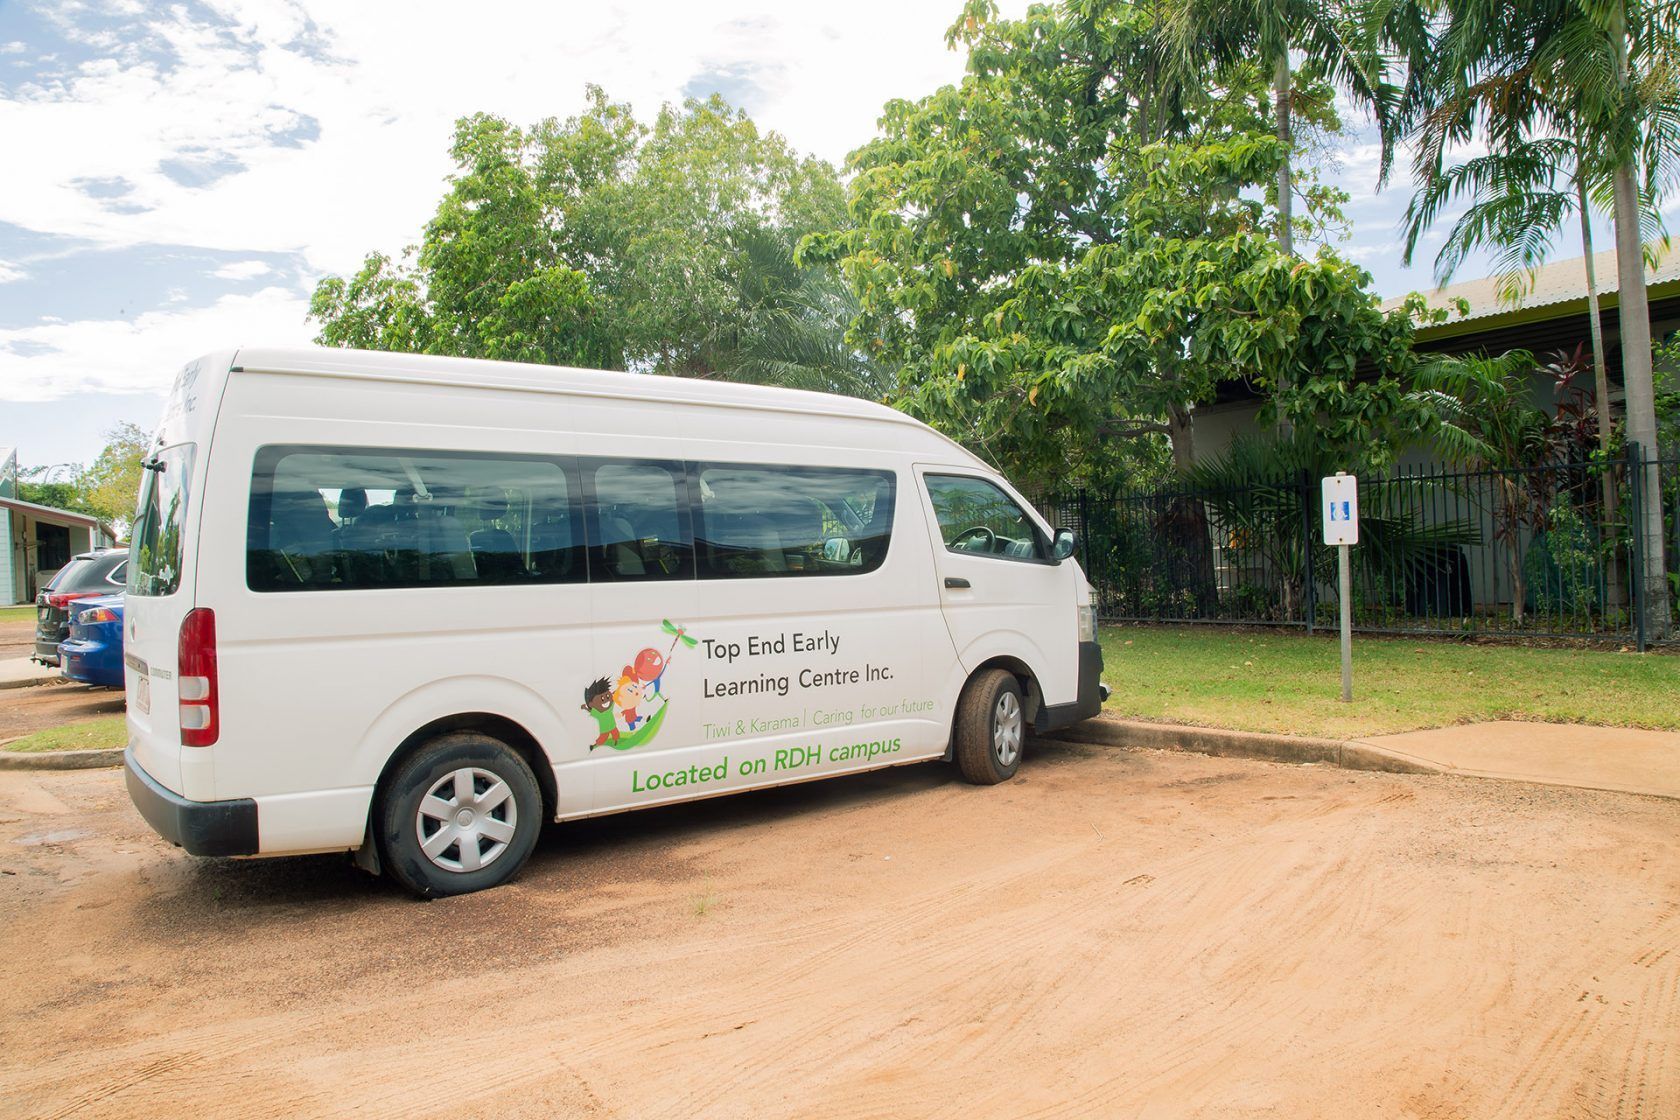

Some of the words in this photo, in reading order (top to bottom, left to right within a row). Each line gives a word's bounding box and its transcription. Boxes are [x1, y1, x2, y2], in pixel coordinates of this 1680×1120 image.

[702, 639, 740, 663] Top
[748, 633, 785, 656] End
[793, 630, 839, 655] Early
[704, 673, 788, 698] Learning
[799, 669, 859, 688] Centre
[866, 664, 893, 681] Inc.
[703, 722, 731, 740] Tiwi
[735, 720, 745, 736] &
[751, 717, 799, 734] Karama
[813, 710, 853, 727] Caring
[861, 704, 876, 718] for
[880, 705, 900, 717] our
[901, 699, 933, 712] future
[631, 757, 728, 793] Located
[739, 759, 767, 777] on
[774, 745, 821, 770] RDH
[829, 738, 901, 762] campus
